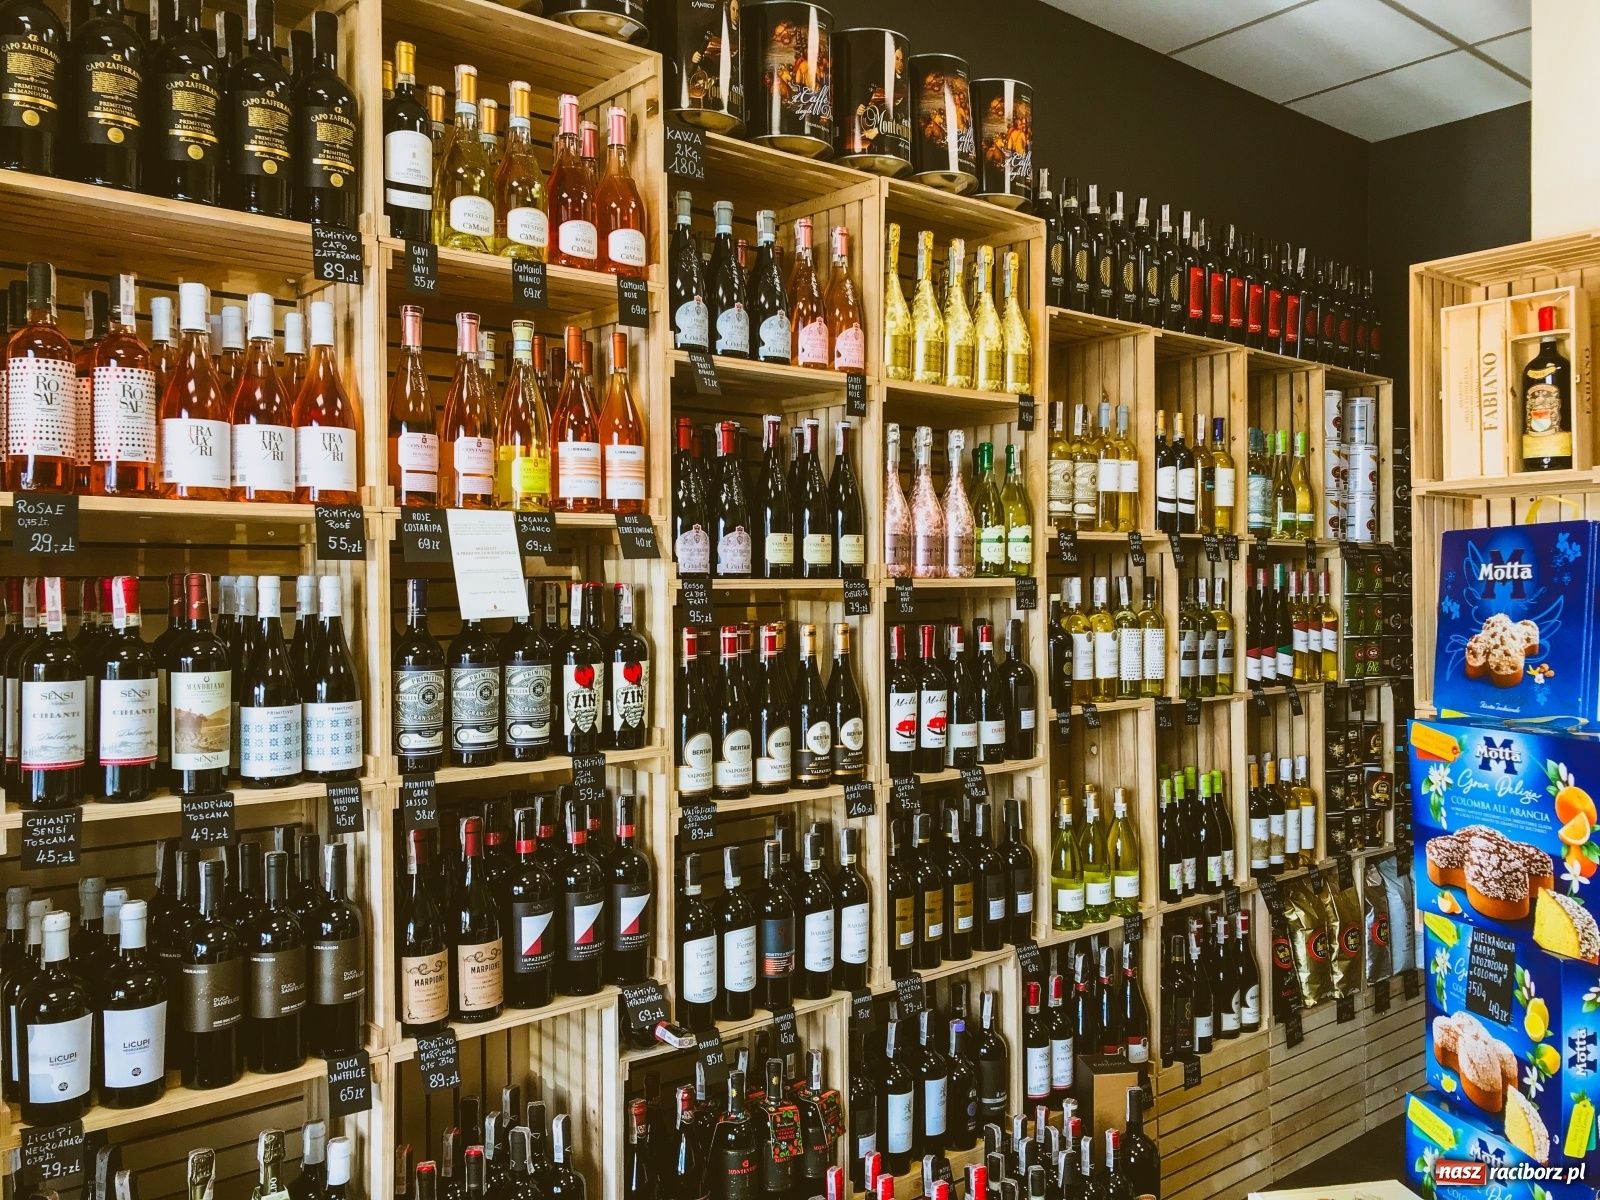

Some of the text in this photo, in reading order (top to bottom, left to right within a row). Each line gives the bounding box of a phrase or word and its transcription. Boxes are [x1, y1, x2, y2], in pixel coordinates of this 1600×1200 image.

[86, 62, 105, 71] CAPO
[14, 83, 49, 93] PRIMITIVO
[166, 81, 184, 90] CAPO
[17, 89, 52, 100] MANDURIA
[99, 101, 132, 111] PRIMITIVO
[242, 98, 260, 106] CAPO
[103, 107, 136, 118] MANDURIA
[311, 114, 328, 122] CAPO
[179, 119, 211, 128] PRIMITIVO
[183, 124, 214, 135] MANDURIA
[254, 135, 284, 144] PRIMITIVO
[667, 127, 701, 145] KAWA
[258, 140, 287, 151] MANDURIA
[323, 149, 350, 158] PRIMITIVO
[322, 241, 347, 250] CAPO
[412, 246, 428, 256] GAVI
[315, 249, 361, 261] ZAFFERANO
[412, 264, 429, 274] GAVI
[519, 275, 540, 284] BIANCO
[36, 375, 59, 392] RO
[121, 384, 144, 400] RO
[1483, 352, 1498, 431] FABIANO
[33, 389, 60, 406] SAE
[119, 398, 144, 413] SAE
[259, 431, 283, 442] TRA
[320, 432, 343, 443] TRA
[16, 500, 65, 514] ROSAE
[412, 513, 431, 522] ROSE
[404, 524, 442, 533] COSTARIPA
[1478, 562, 1533, 581] Motta
[40, 691, 74, 701] SENSI
[120, 688, 150, 698] SENSI
[621, 690, 643, 704] ZIN
[572, 694, 596, 708] ZIN
[33, 711, 80, 719] CHIANTI
[113, 708, 155, 716] CHIANTI
[1475, 744, 1522, 762] Motta
[406, 780, 434, 789] PRIMITIVO
[846, 784, 872, 793] AMARONE
[1458, 769, 1542, 804] Gran Delizia
[329, 787, 359, 796] PRIMITIVO
[333, 796, 360, 805] VIGLIONE
[1451, 795, 1491, 811] COLOMBA
[1509, 808, 1550, 822] ARANCIA
[186, 811, 230, 821] TOSCANA
[24, 835, 75, 847] TOSCANA
[1474, 932, 1515, 952] WIELKANOCNA
[1474, 944, 1495, 957] BABKA
[470, 962, 500, 974] MARPIONE
[414, 974, 445, 987] MARPIONE
[699, 1038, 719, 1050] BAROLO
[1576, 1028, 1587, 1077] Motta
[337, 1058, 358, 1070] DUCA
[329, 1068, 366, 1084] SANFELICE
